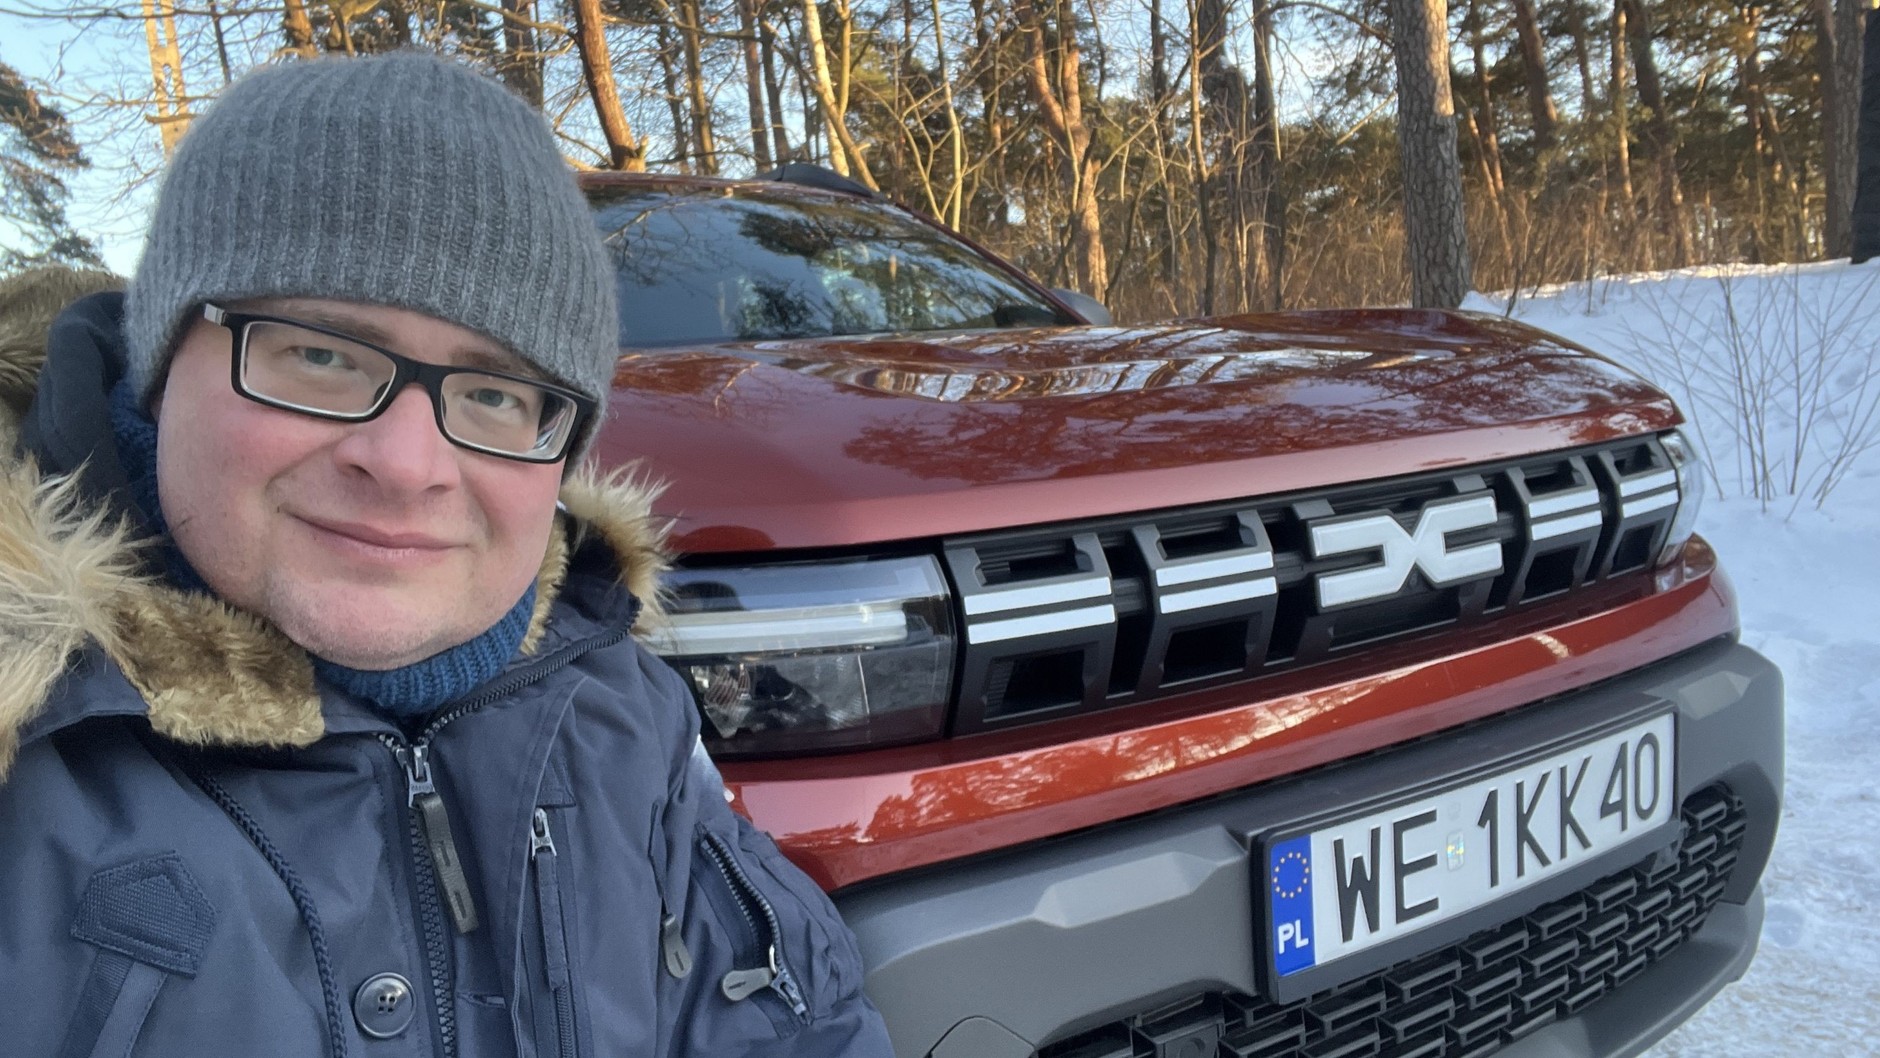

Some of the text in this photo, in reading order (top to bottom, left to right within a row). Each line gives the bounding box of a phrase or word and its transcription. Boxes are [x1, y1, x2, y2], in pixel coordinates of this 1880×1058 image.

[1333, 732, 1660, 943] WE 1KK40
[1277, 920, 1309, 954] PL
